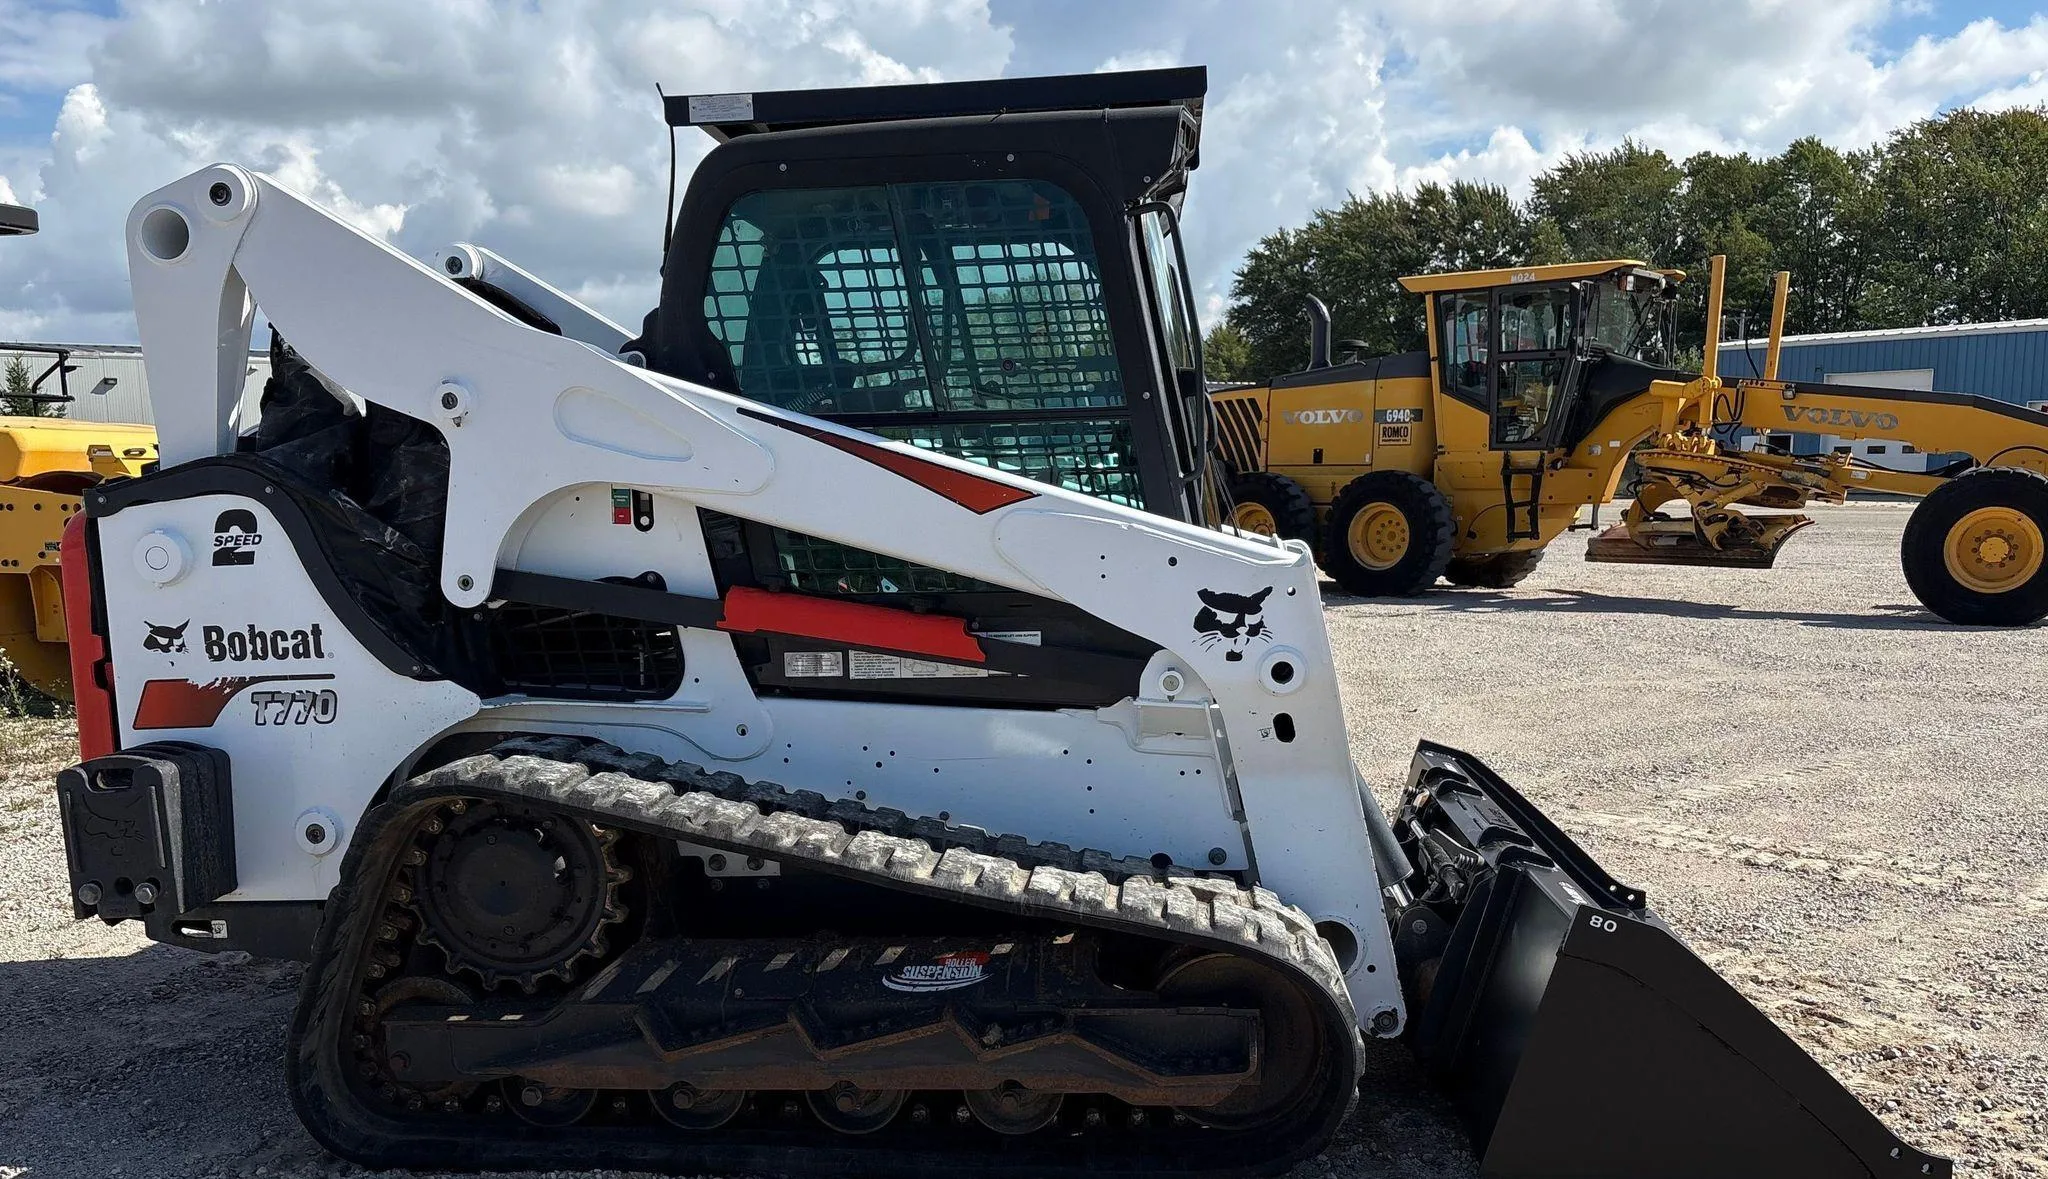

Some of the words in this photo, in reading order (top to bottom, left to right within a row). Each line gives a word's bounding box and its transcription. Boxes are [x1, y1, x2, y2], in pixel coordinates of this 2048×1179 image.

[1281, 409, 1364, 425] VOLVO
[1781, 405, 1899, 430] VOLVO
[1382, 426, 1409, 438] ROMCO
[212, 508, 258, 566] 2
[213, 534, 263, 547] SPEED
[203, 623, 325, 662] Bobcat
[251, 689, 338, 726] T770
[1589, 915, 1618, 933] 80
[945, 957, 977, 967] ROLLER
[902, 964, 983, 980] SUSPENSION
